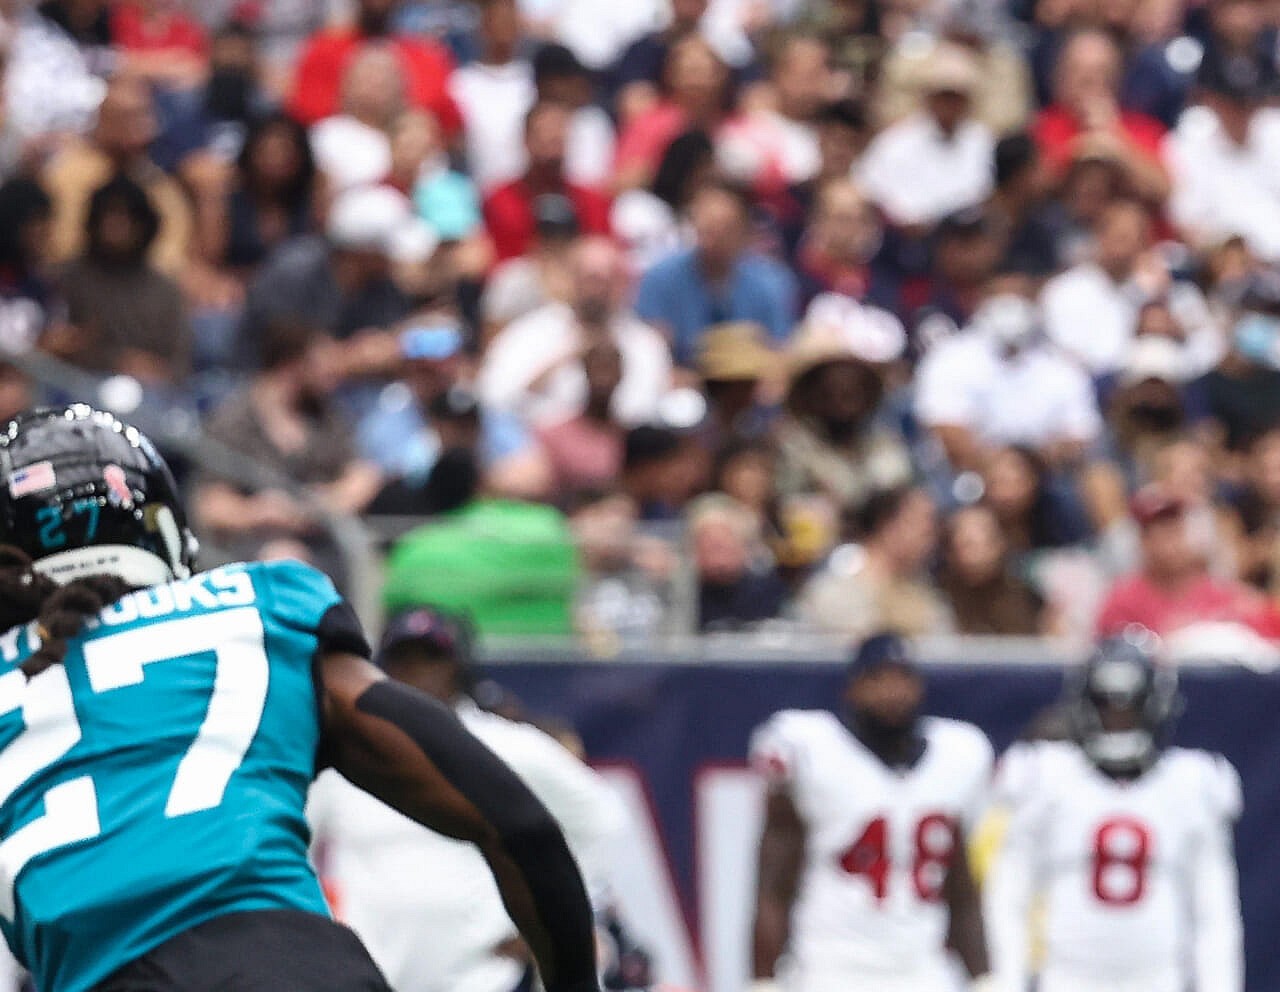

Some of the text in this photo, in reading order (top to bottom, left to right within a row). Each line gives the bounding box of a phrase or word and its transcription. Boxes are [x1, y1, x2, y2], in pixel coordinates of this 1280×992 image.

[35, 499, 99, 548] 27
[0, 607, 269, 922] 27
[838, 812, 959, 906] 48
[1092, 813, 1154, 908] 8
